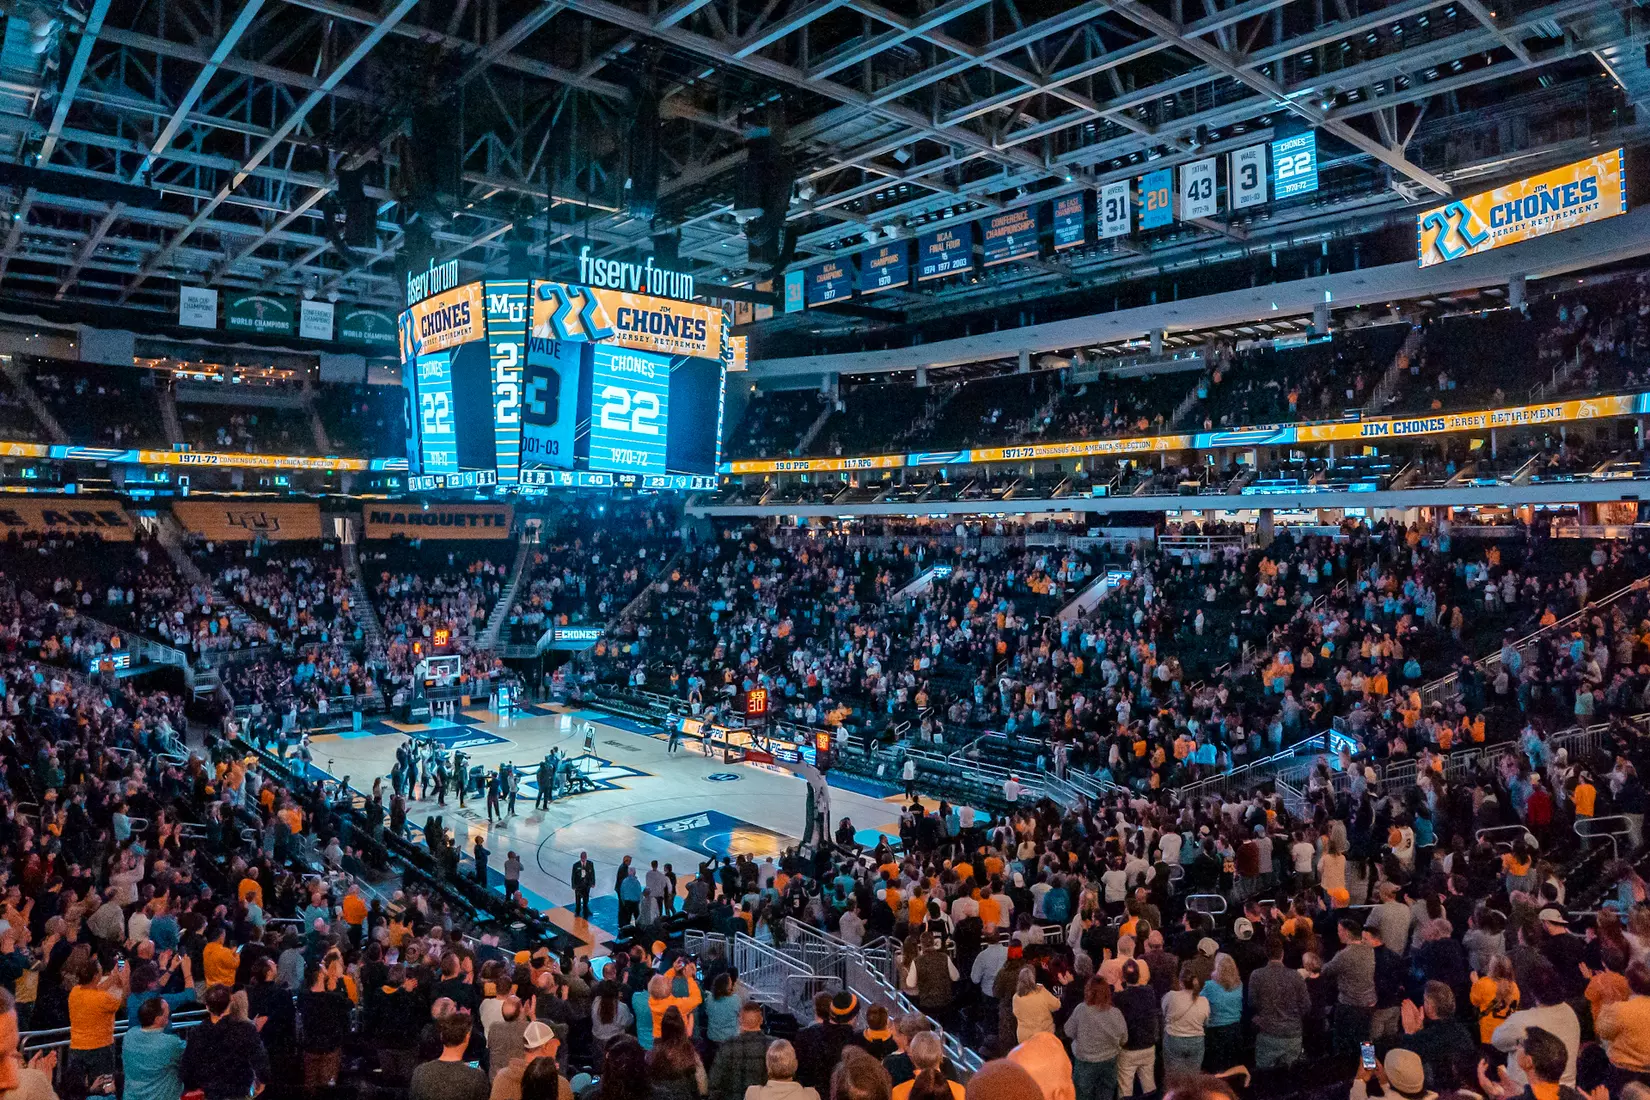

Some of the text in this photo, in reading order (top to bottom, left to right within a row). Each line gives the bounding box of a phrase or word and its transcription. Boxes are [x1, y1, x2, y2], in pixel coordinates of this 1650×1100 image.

[1281, 138, 1305, 151] CHONES
[1278, 152, 1312, 179] 22
[1241, 163, 1258, 190] 3
[1187, 178, 1212, 201] 43
[1533, 184, 1548, 193] JIM
[1106, 196, 1127, 222] 31
[1147, 188, 1168, 211] 20
[1490, 176, 1598, 229] CHONES
[992, 210, 1028, 228] CONFERENCE
[1491, 202, 1600, 238] JERSEY RETIREMENT
[986, 219, 1035, 239] CHAMPIONSHIPS
[1422, 201, 1489, 262] 22
[946, 239, 961, 250] FOUR
[579, 245, 694, 300] fiserv.forum
[953, 258, 967, 269] 2003
[824, 290, 836, 300] 1977
[489, 294, 525, 323] MU
[537, 282, 615, 343] 22
[231, 317, 253, 326] WORLD
[254, 319, 290, 330] CHAMPIONS
[421, 301, 471, 338] CHONES
[616, 307, 707, 341] CHONES
[343, 330, 363, 339] WORLD
[363, 332, 396, 342] CHAMPIONS
[616, 334, 707, 351] JERSEY RETIREMENT
[527, 337, 561, 360] WADE
[611, 355, 655, 379] CHONES
[523, 365, 560, 428] 3
[422, 391, 451, 434] 22
[601, 385, 660, 435] 22
[1361, 407, 1563, 437] JIM CHONES JERSEY RETIREMENT
[610, 447, 649, 466] 1970-72
[1001, 447, 1034, 459] 1971-72
[1035, 448, 1069, 456] CONSENSUS
[1115, 440, 1151, 450] SELECTION
[178, 454, 218, 464] 1971-72
[219, 456, 257, 465] CONSENSUS
[793, 461, 809, 470] PPG
[857, 458, 872, 467] RPG
[588, 475, 603, 485] 40
[652, 477, 664, 487] 23
[41, 510, 129, 527] ARE
[368, 510, 506, 528] MARQUETTE
[434, 636, 446, 645] 30
[561, 630, 597, 639] CHONES
[749, 700, 764, 712] 30
